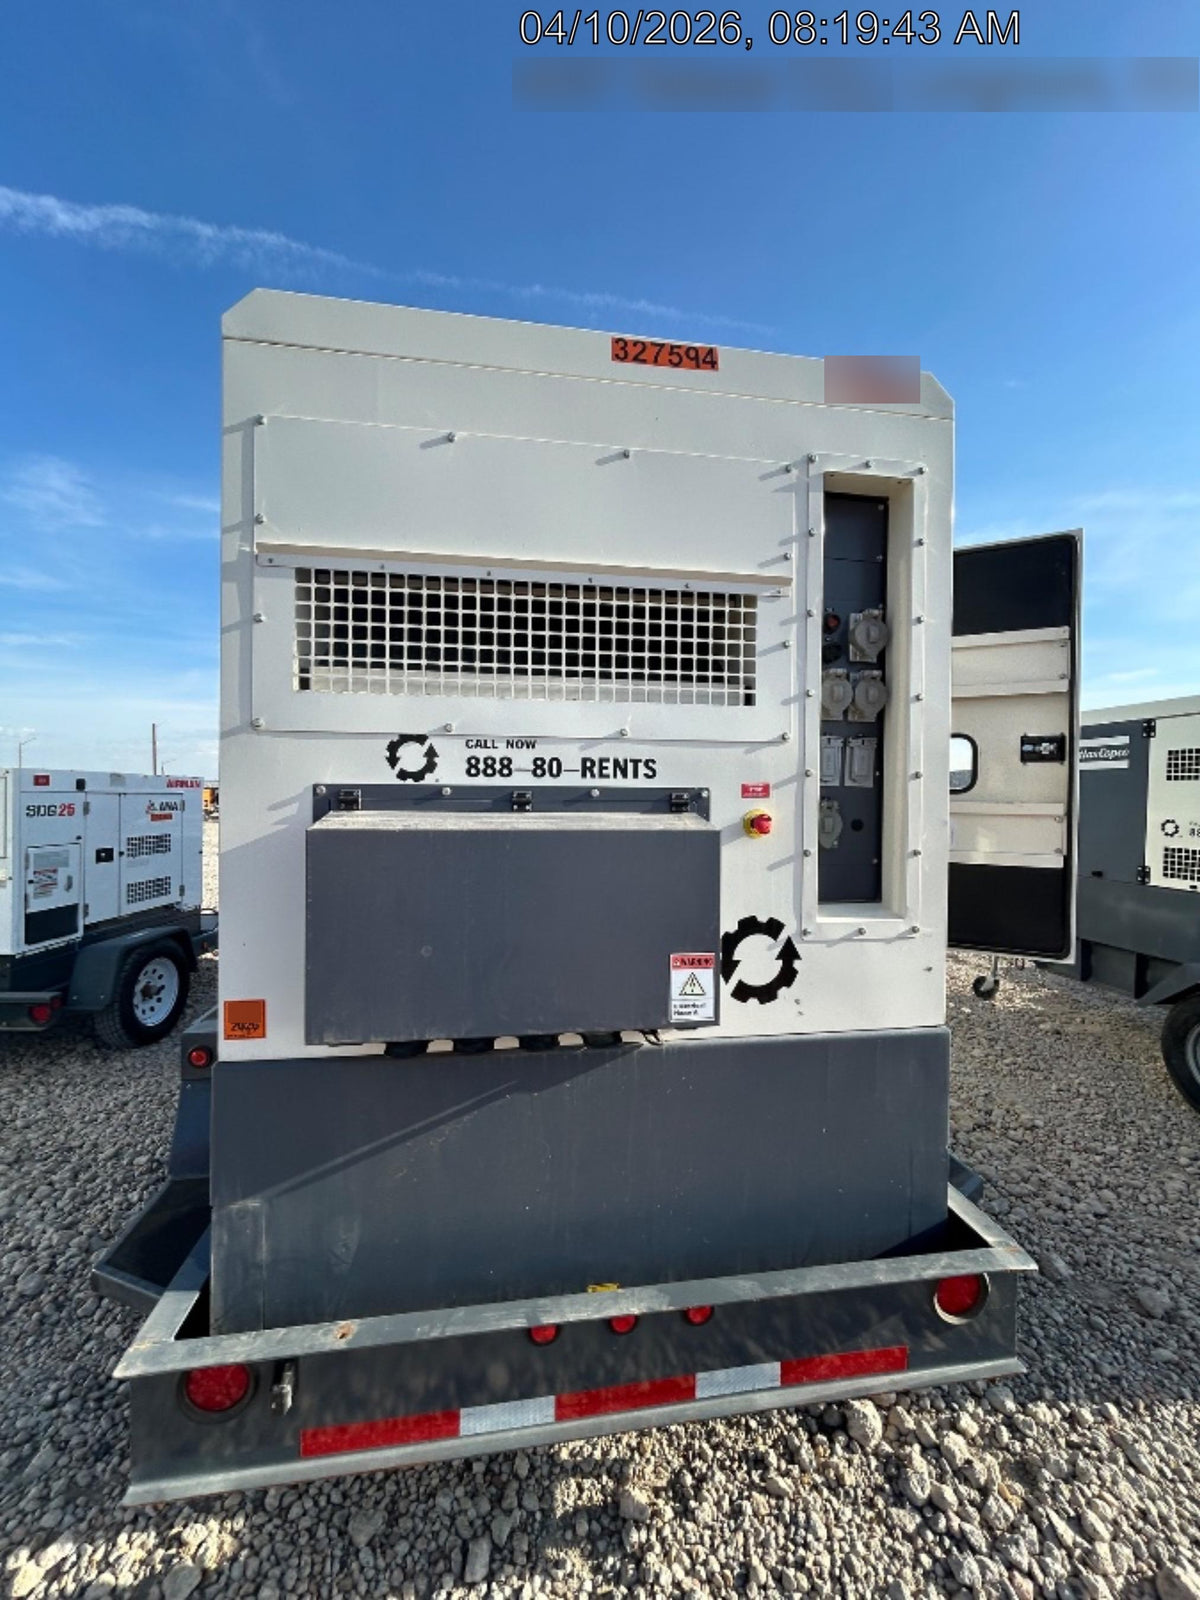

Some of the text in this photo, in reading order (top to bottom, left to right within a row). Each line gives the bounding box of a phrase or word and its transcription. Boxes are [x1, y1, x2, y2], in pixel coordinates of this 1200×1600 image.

[614, 338, 717, 369] 327594
[465, 739, 537, 750] CALL NOW
[465, 755, 657, 780] 888-80-RENTS
